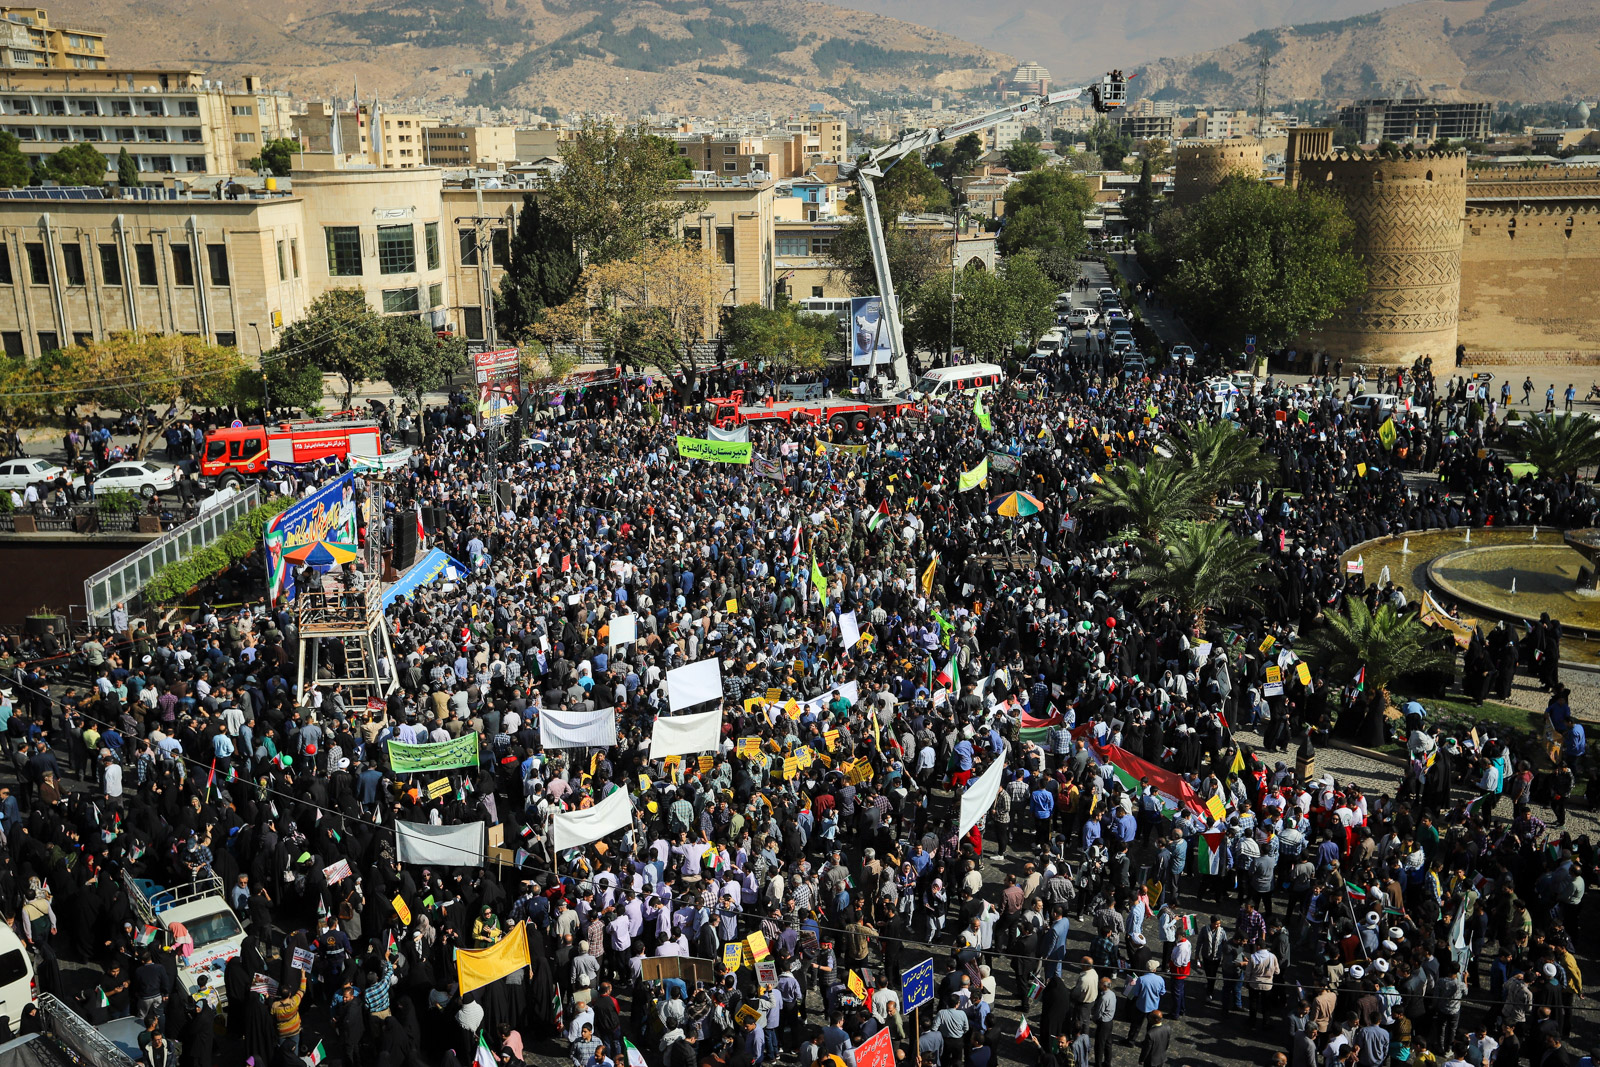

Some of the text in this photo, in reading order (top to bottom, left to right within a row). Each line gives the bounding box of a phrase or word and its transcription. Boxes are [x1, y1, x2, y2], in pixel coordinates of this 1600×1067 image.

[713, 448, 748, 459] دبیرستان
[903, 965, 932, 987] دبیرستان مهندس
[857, 1033, 889, 1063] دبیرستان مهندس
